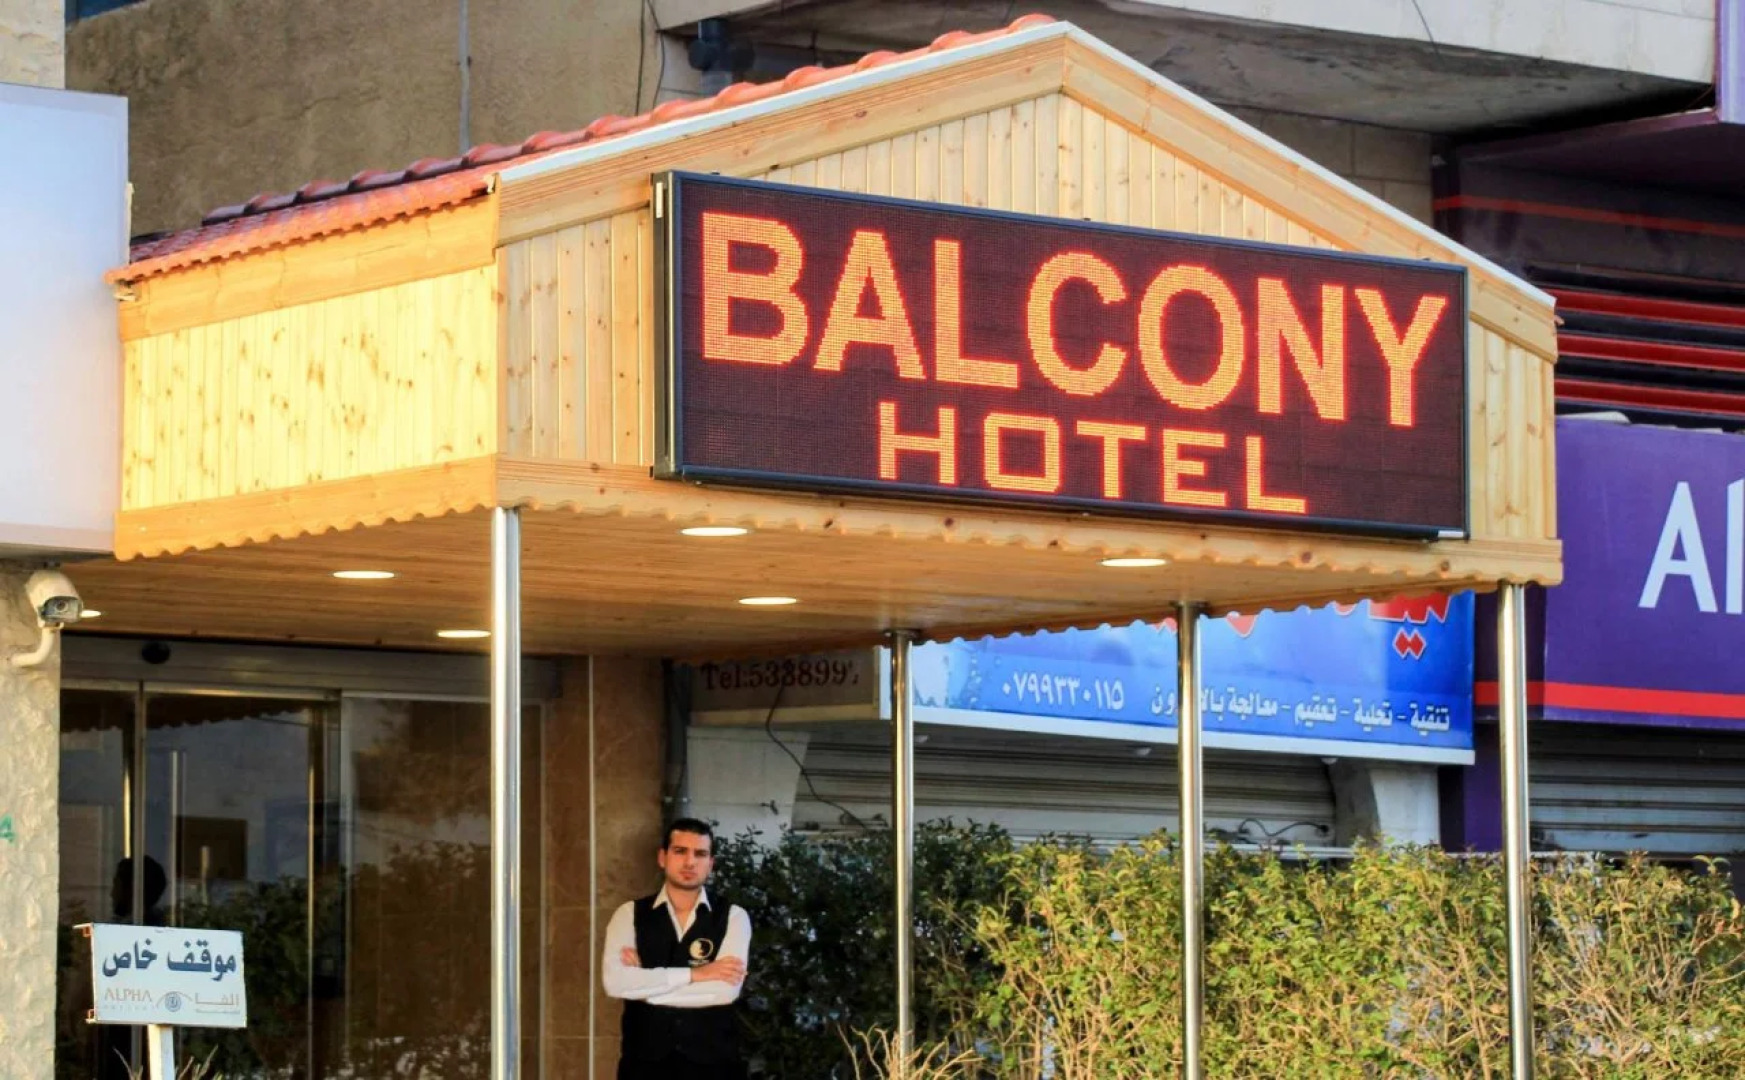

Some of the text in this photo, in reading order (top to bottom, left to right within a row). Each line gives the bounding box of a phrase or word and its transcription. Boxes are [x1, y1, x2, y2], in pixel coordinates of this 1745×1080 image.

[702, 211, 1447, 428] BALCONY
[879, 402, 1307, 514] HOTEL
[1227, 686, 1278, 721] معالجة
[1295, 695, 1337, 728] تعقيم
[1352, 697, 1393, 732] تحلية
[1409, 701, 1450, 736] تنقية
[102, 937, 237, 982] موقف خاص
[104, 987, 153, 1003] ALPHA
